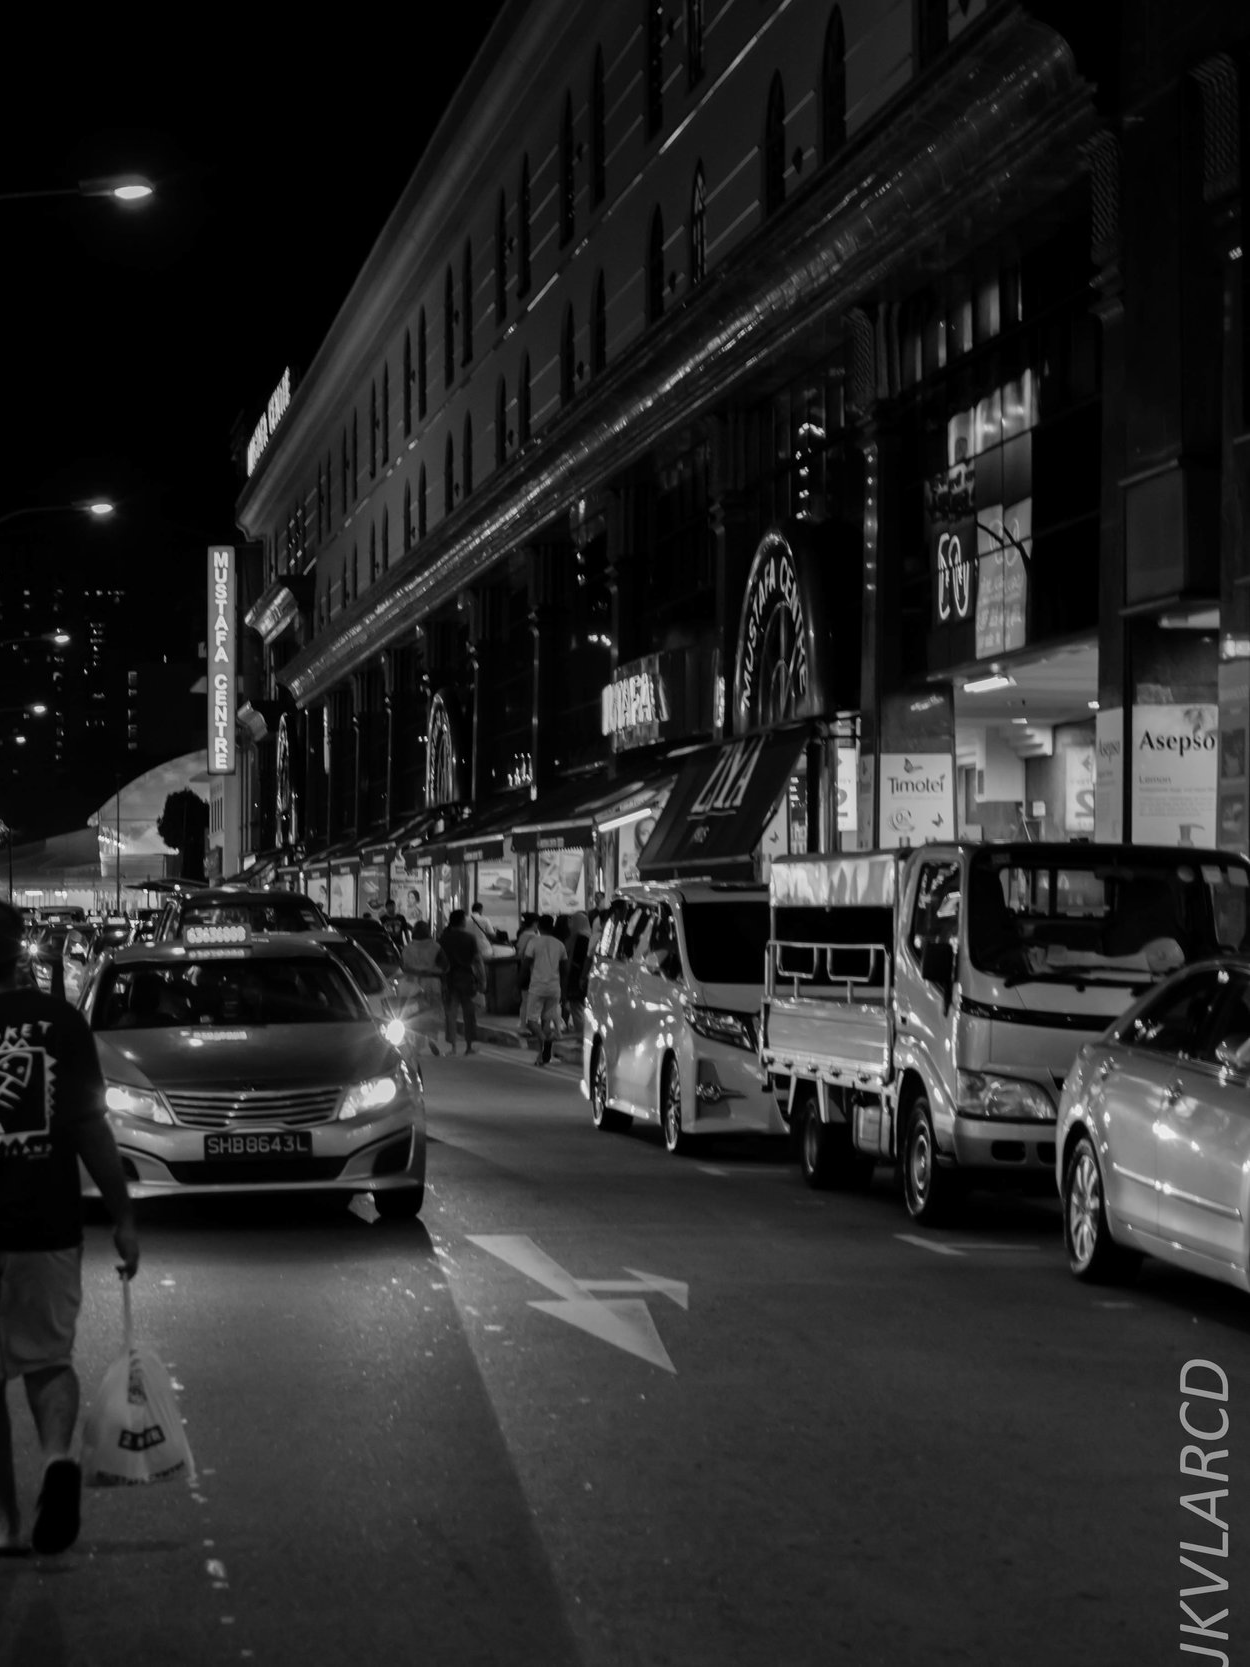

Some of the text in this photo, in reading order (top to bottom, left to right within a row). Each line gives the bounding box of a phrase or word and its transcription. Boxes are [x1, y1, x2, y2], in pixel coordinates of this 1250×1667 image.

[740, 556, 777, 713] MUSTAFA
[213, 551, 229, 770] MUSTAFA CENTRE
[1139, 719, 1216, 757] Asepso
[887, 773, 946, 795] Timotei
[207, 1134, 309, 1154] SHB8643L
